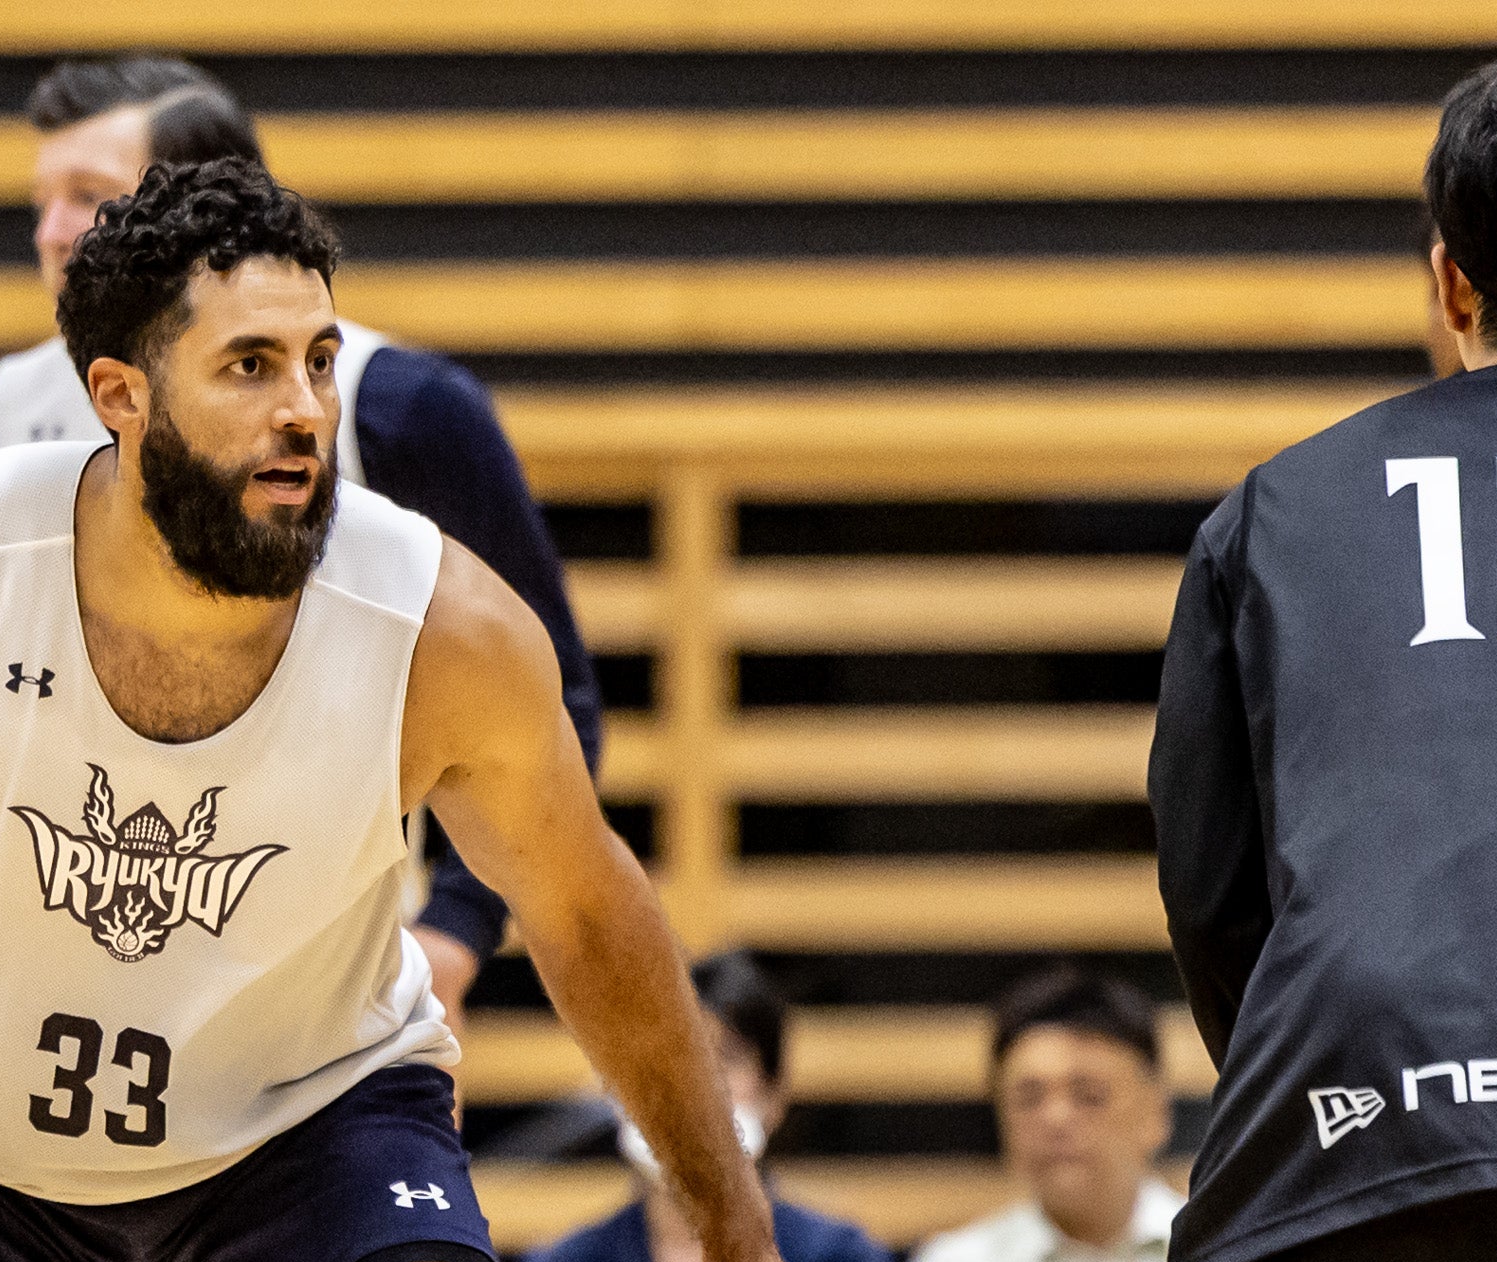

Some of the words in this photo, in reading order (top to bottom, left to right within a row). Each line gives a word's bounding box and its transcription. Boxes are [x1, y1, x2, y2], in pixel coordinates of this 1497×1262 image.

[49, 829, 236, 931] RYUKYU
[118, 840, 171, 855] KINGS
[27, 1012, 172, 1148] 33
